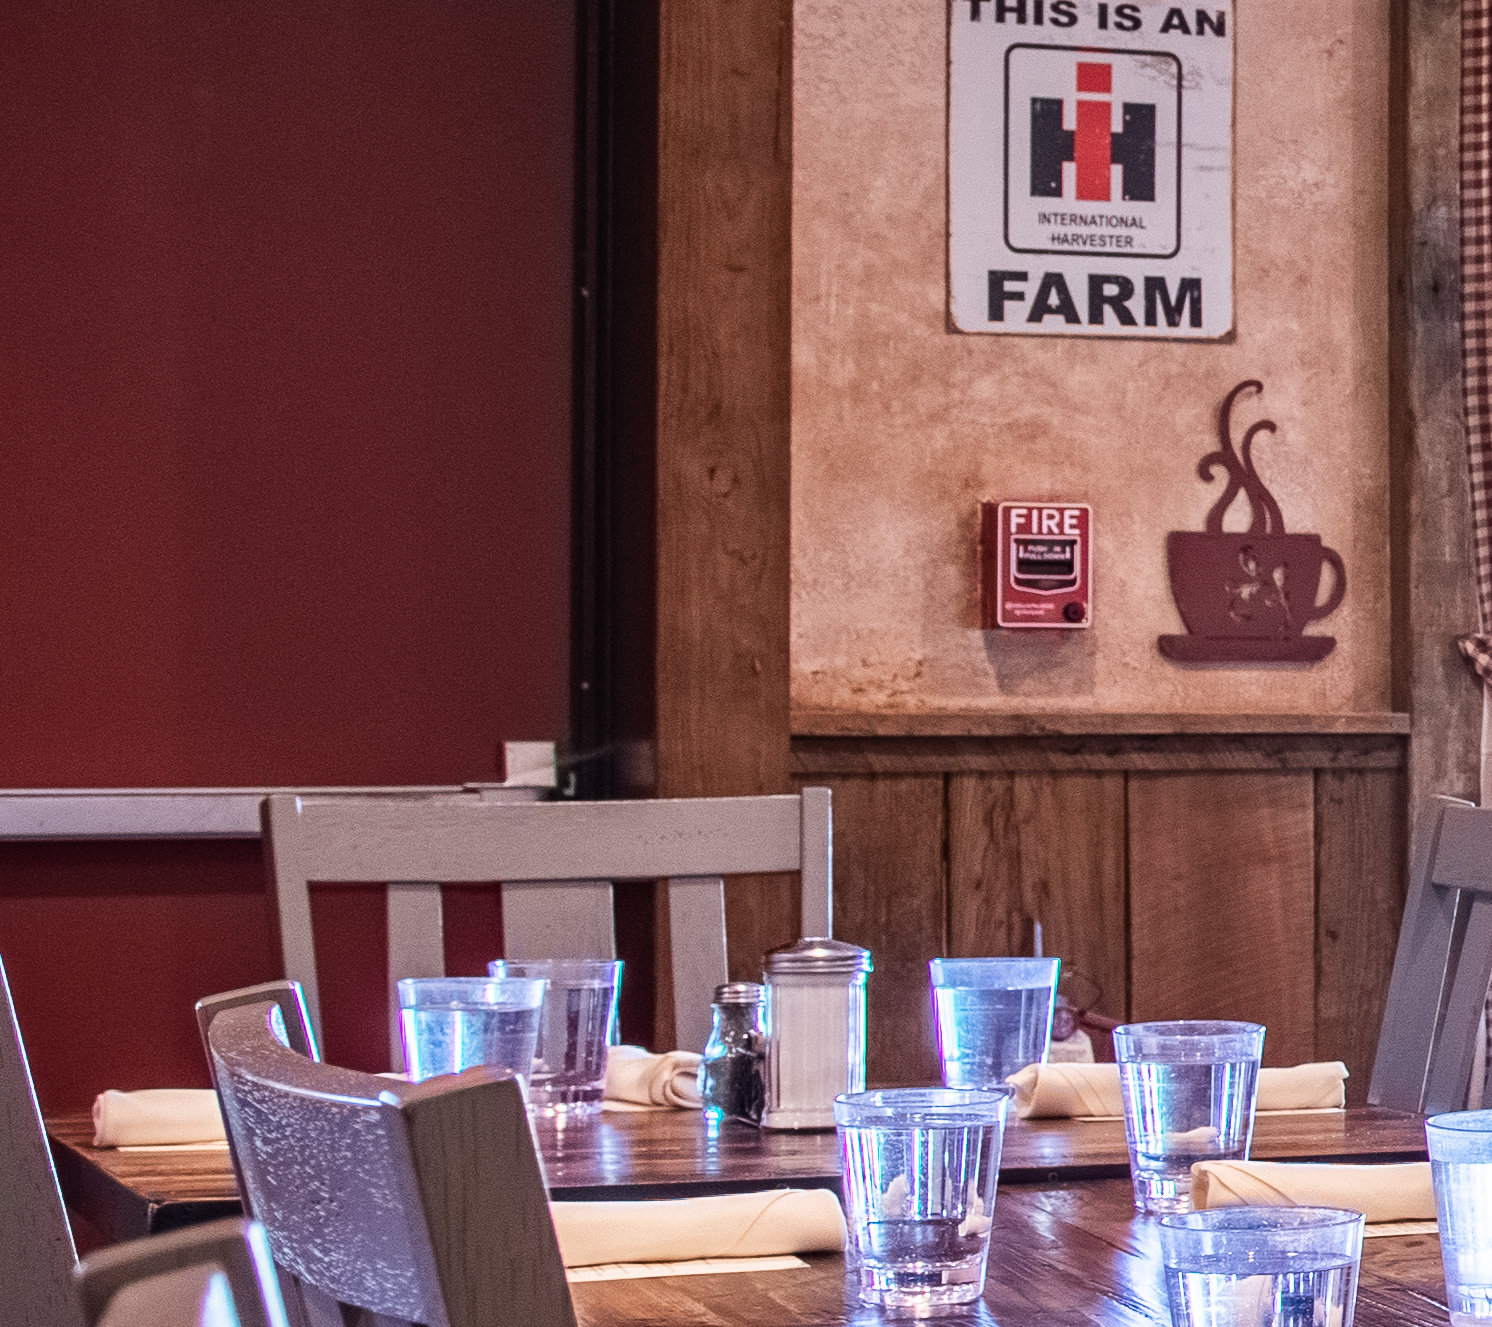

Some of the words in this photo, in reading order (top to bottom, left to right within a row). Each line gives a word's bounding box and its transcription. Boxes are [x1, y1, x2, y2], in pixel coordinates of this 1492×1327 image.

[1098, 2, 1143, 32] IS
[1158, 6, 1227, 38] AN
[1037, 211, 1147, 230] INTERNATIONAL
[1050, 231, 1134, 249] HARVESTER
[986, 269, 1203, 329] FARM
[1010, 508, 1082, 535] FIRE
